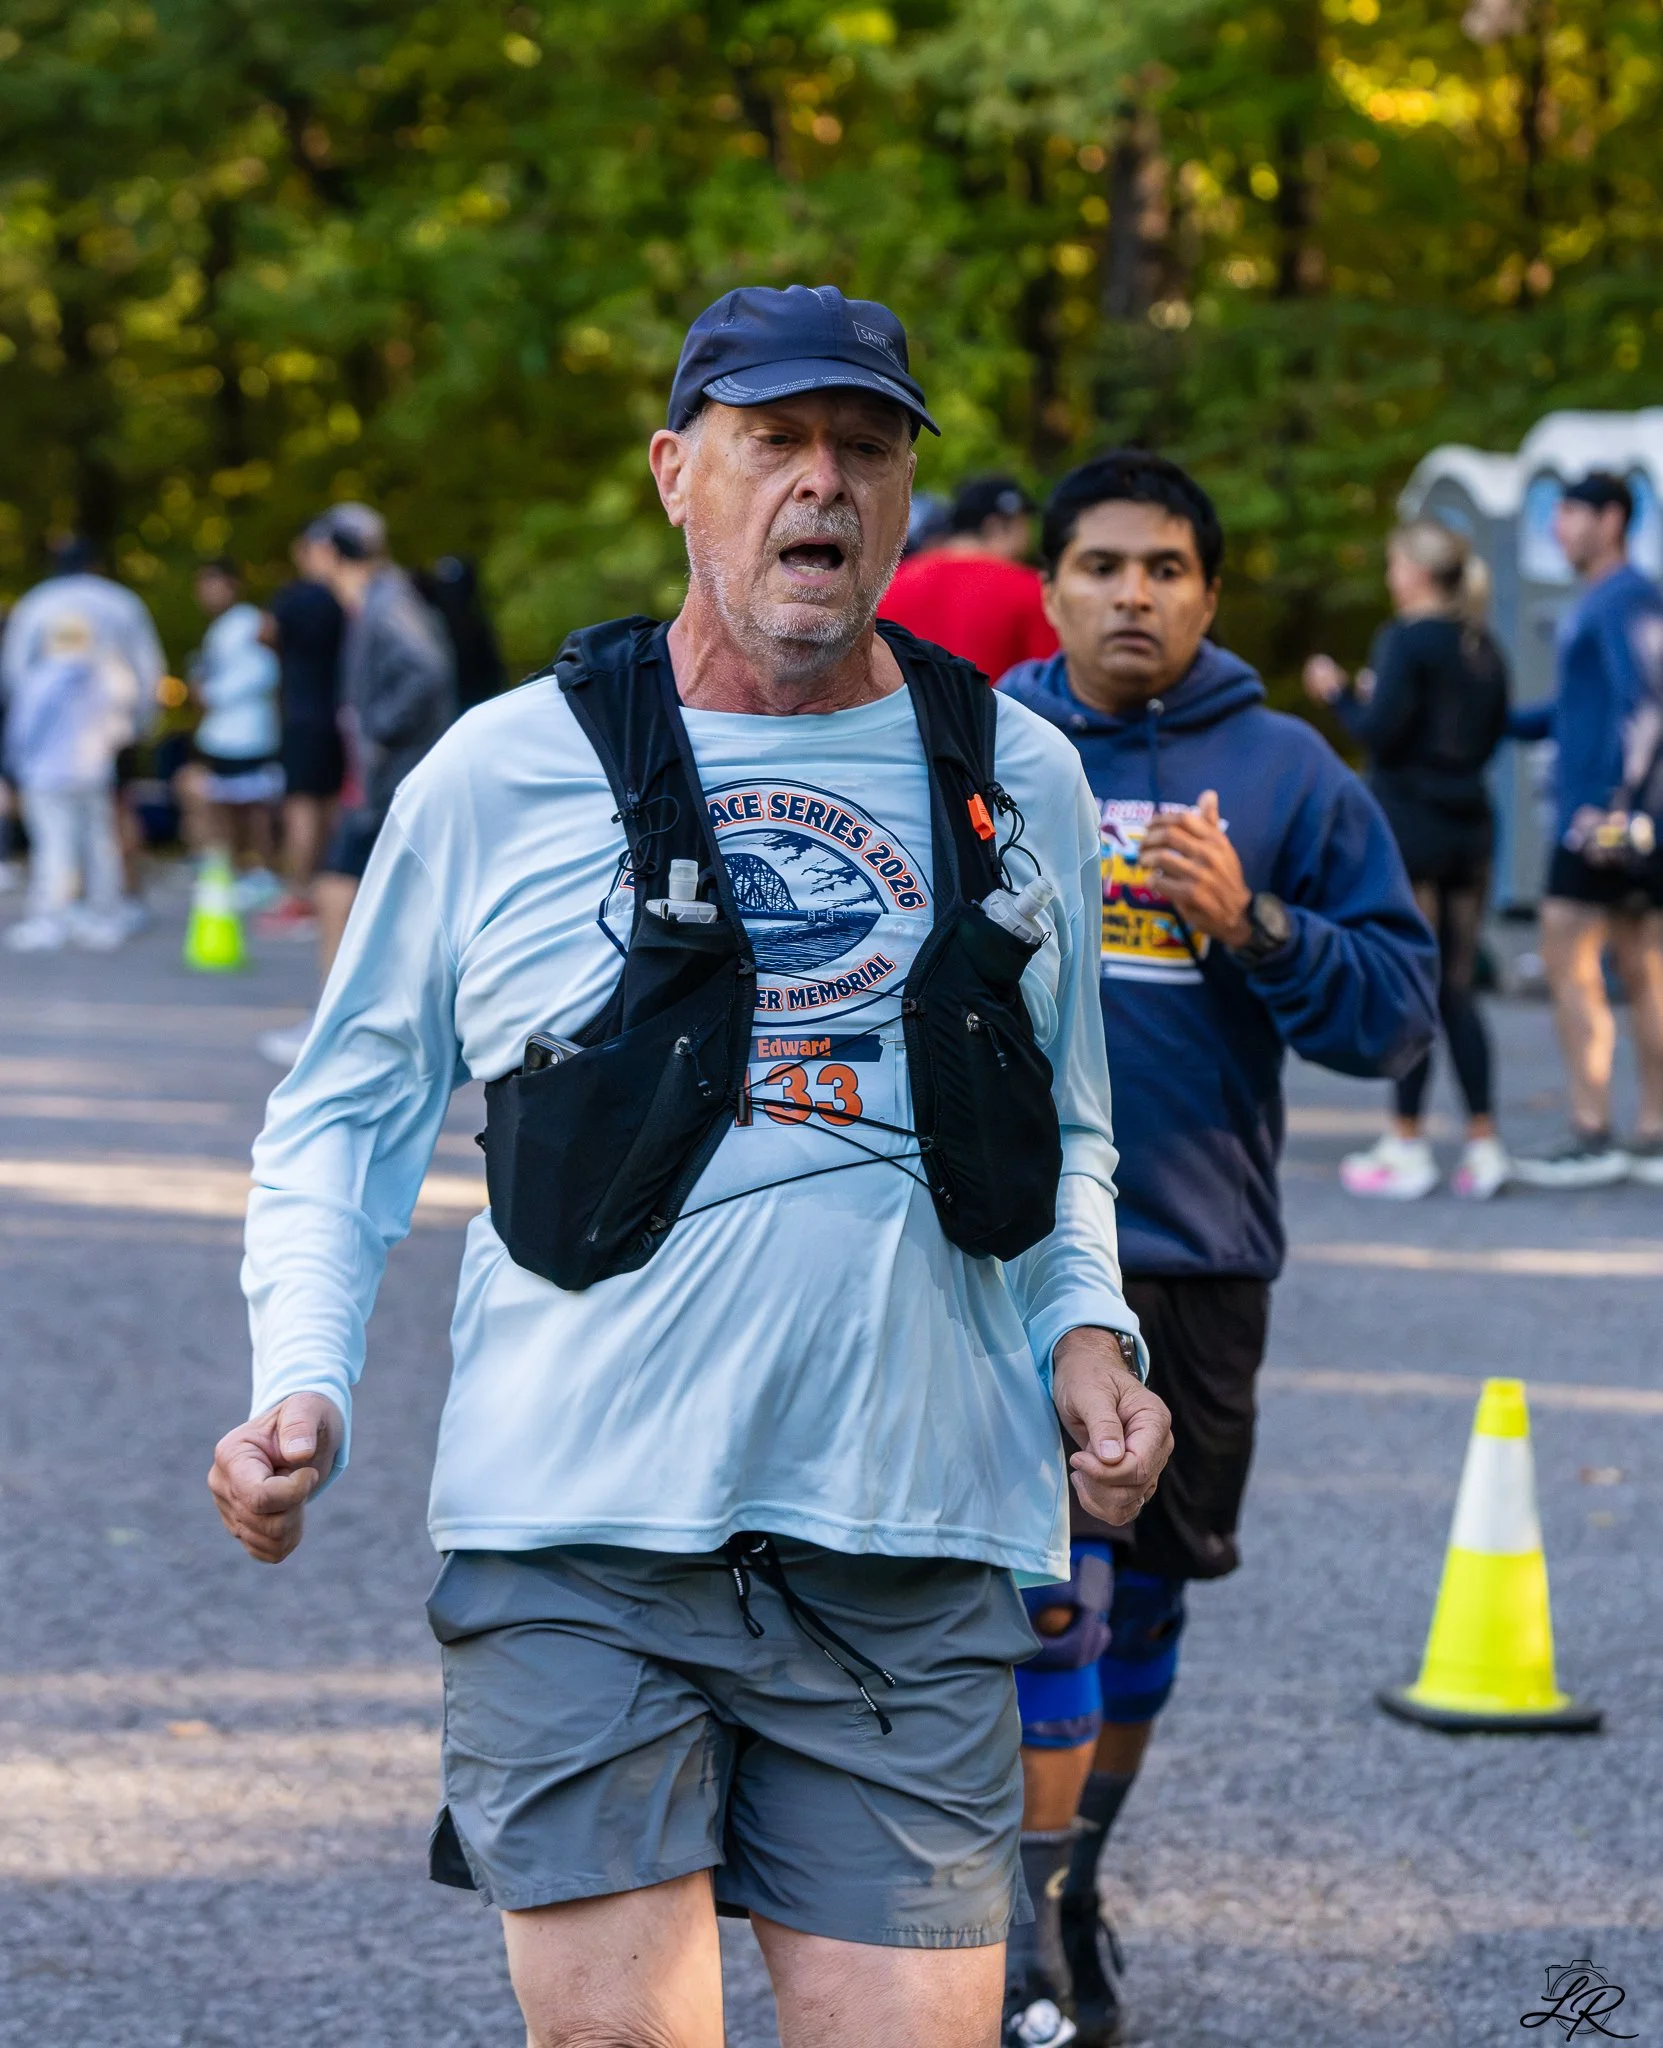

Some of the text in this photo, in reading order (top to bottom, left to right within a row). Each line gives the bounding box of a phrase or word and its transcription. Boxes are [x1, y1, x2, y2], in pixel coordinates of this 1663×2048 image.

[707, 792, 928, 910] ACE SERIES 2026
[753, 952, 896, 1011] ER MEMORIAL
[757, 1037, 832, 1058] Edward
